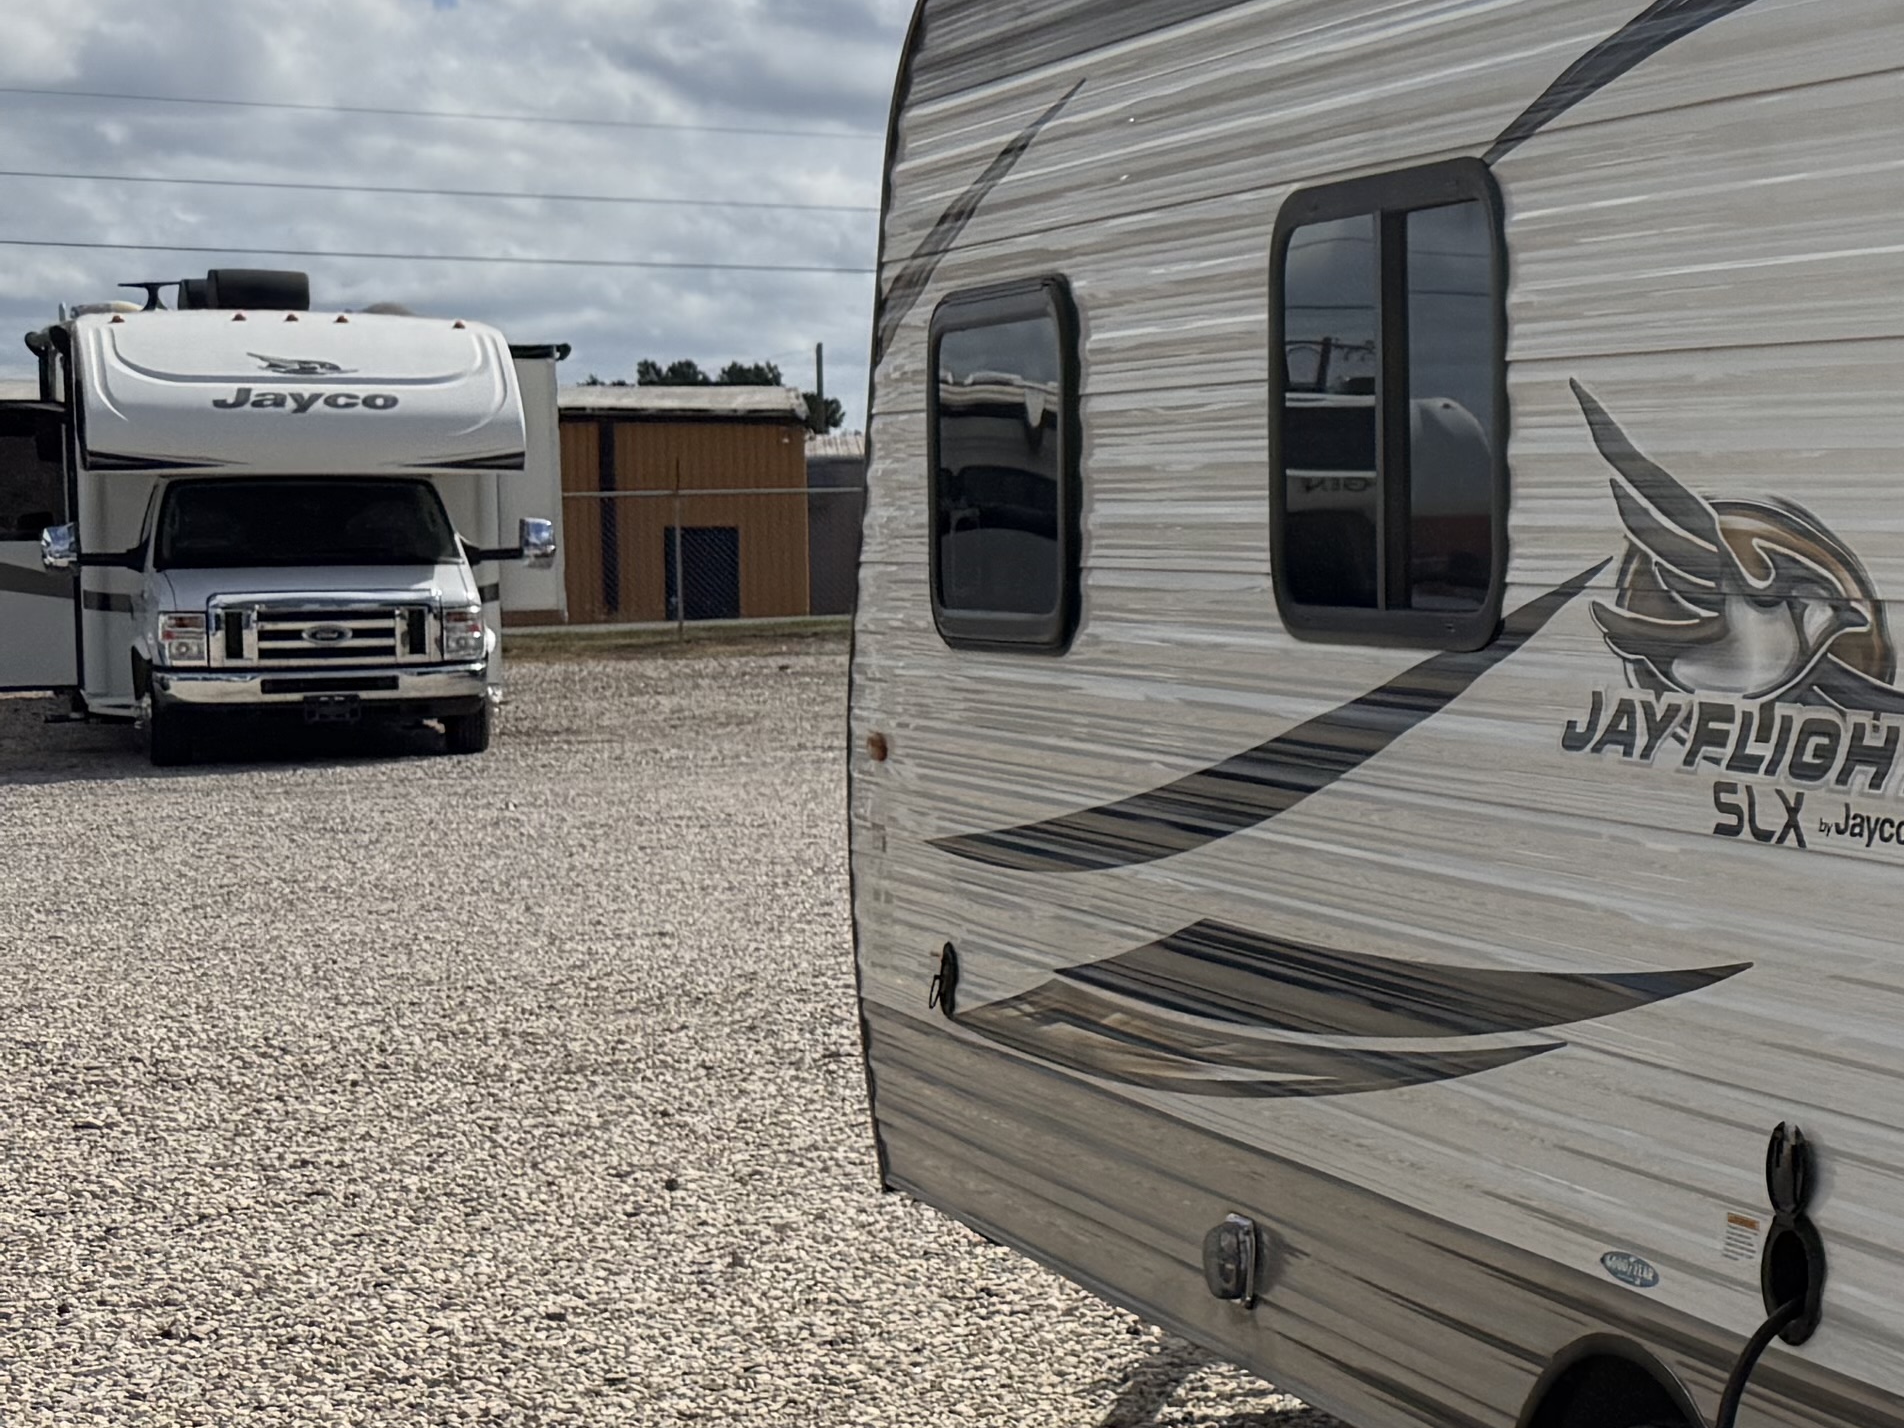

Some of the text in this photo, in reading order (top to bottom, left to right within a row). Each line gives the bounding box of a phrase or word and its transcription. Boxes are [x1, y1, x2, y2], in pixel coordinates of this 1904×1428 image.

[212, 387, 399, 414] Jayco
[1712, 780, 1806, 848] SLX
[1818, 817, 1833, 836] by
